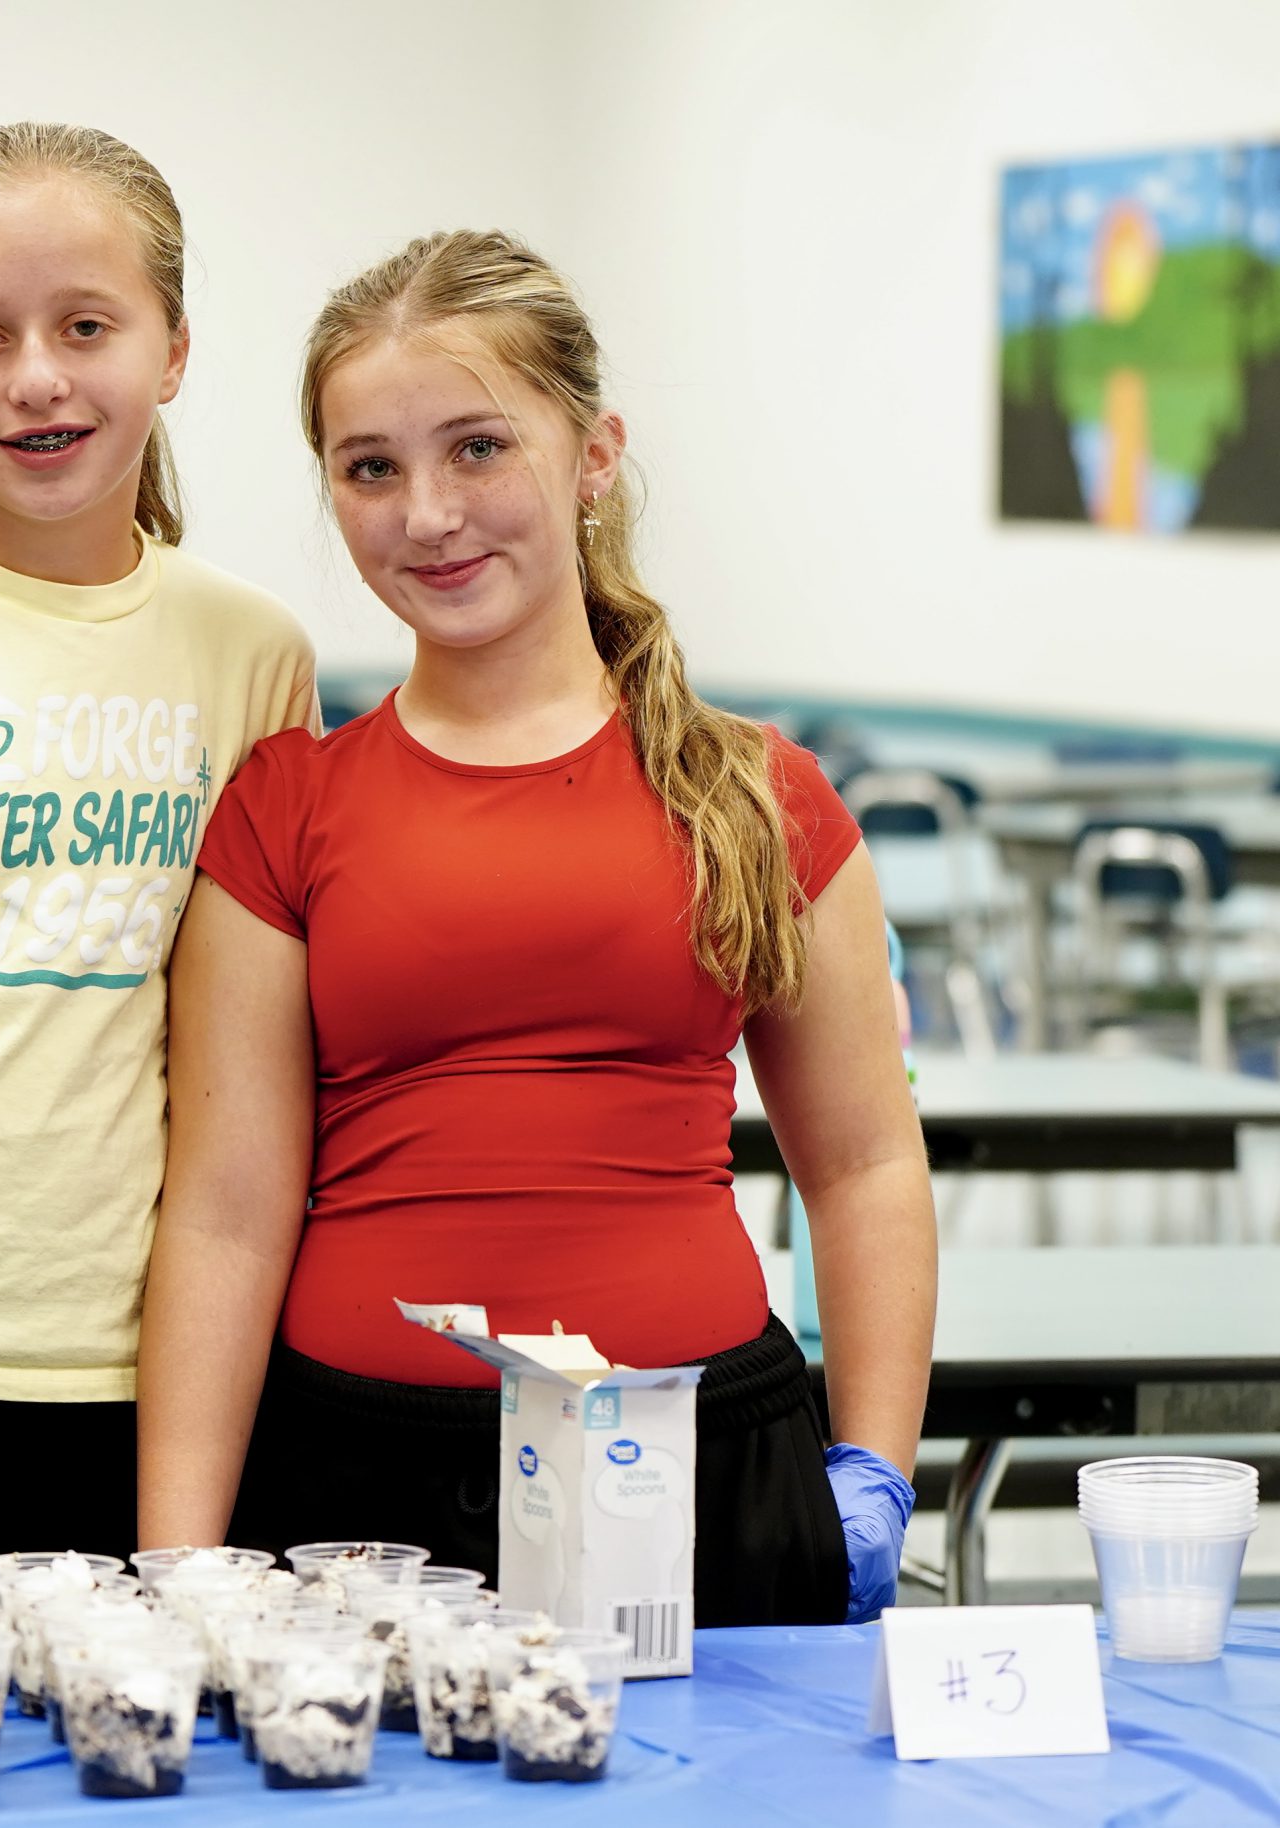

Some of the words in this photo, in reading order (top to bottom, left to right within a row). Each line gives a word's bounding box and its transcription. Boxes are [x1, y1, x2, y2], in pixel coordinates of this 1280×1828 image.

[32, 693, 199, 786] FORGE
[68, 789, 200, 869] SAFARI
[591, 1397, 615, 1417] 48
[624, 1468, 661, 1482] White
[617, 1483, 666, 1499] Spoons
